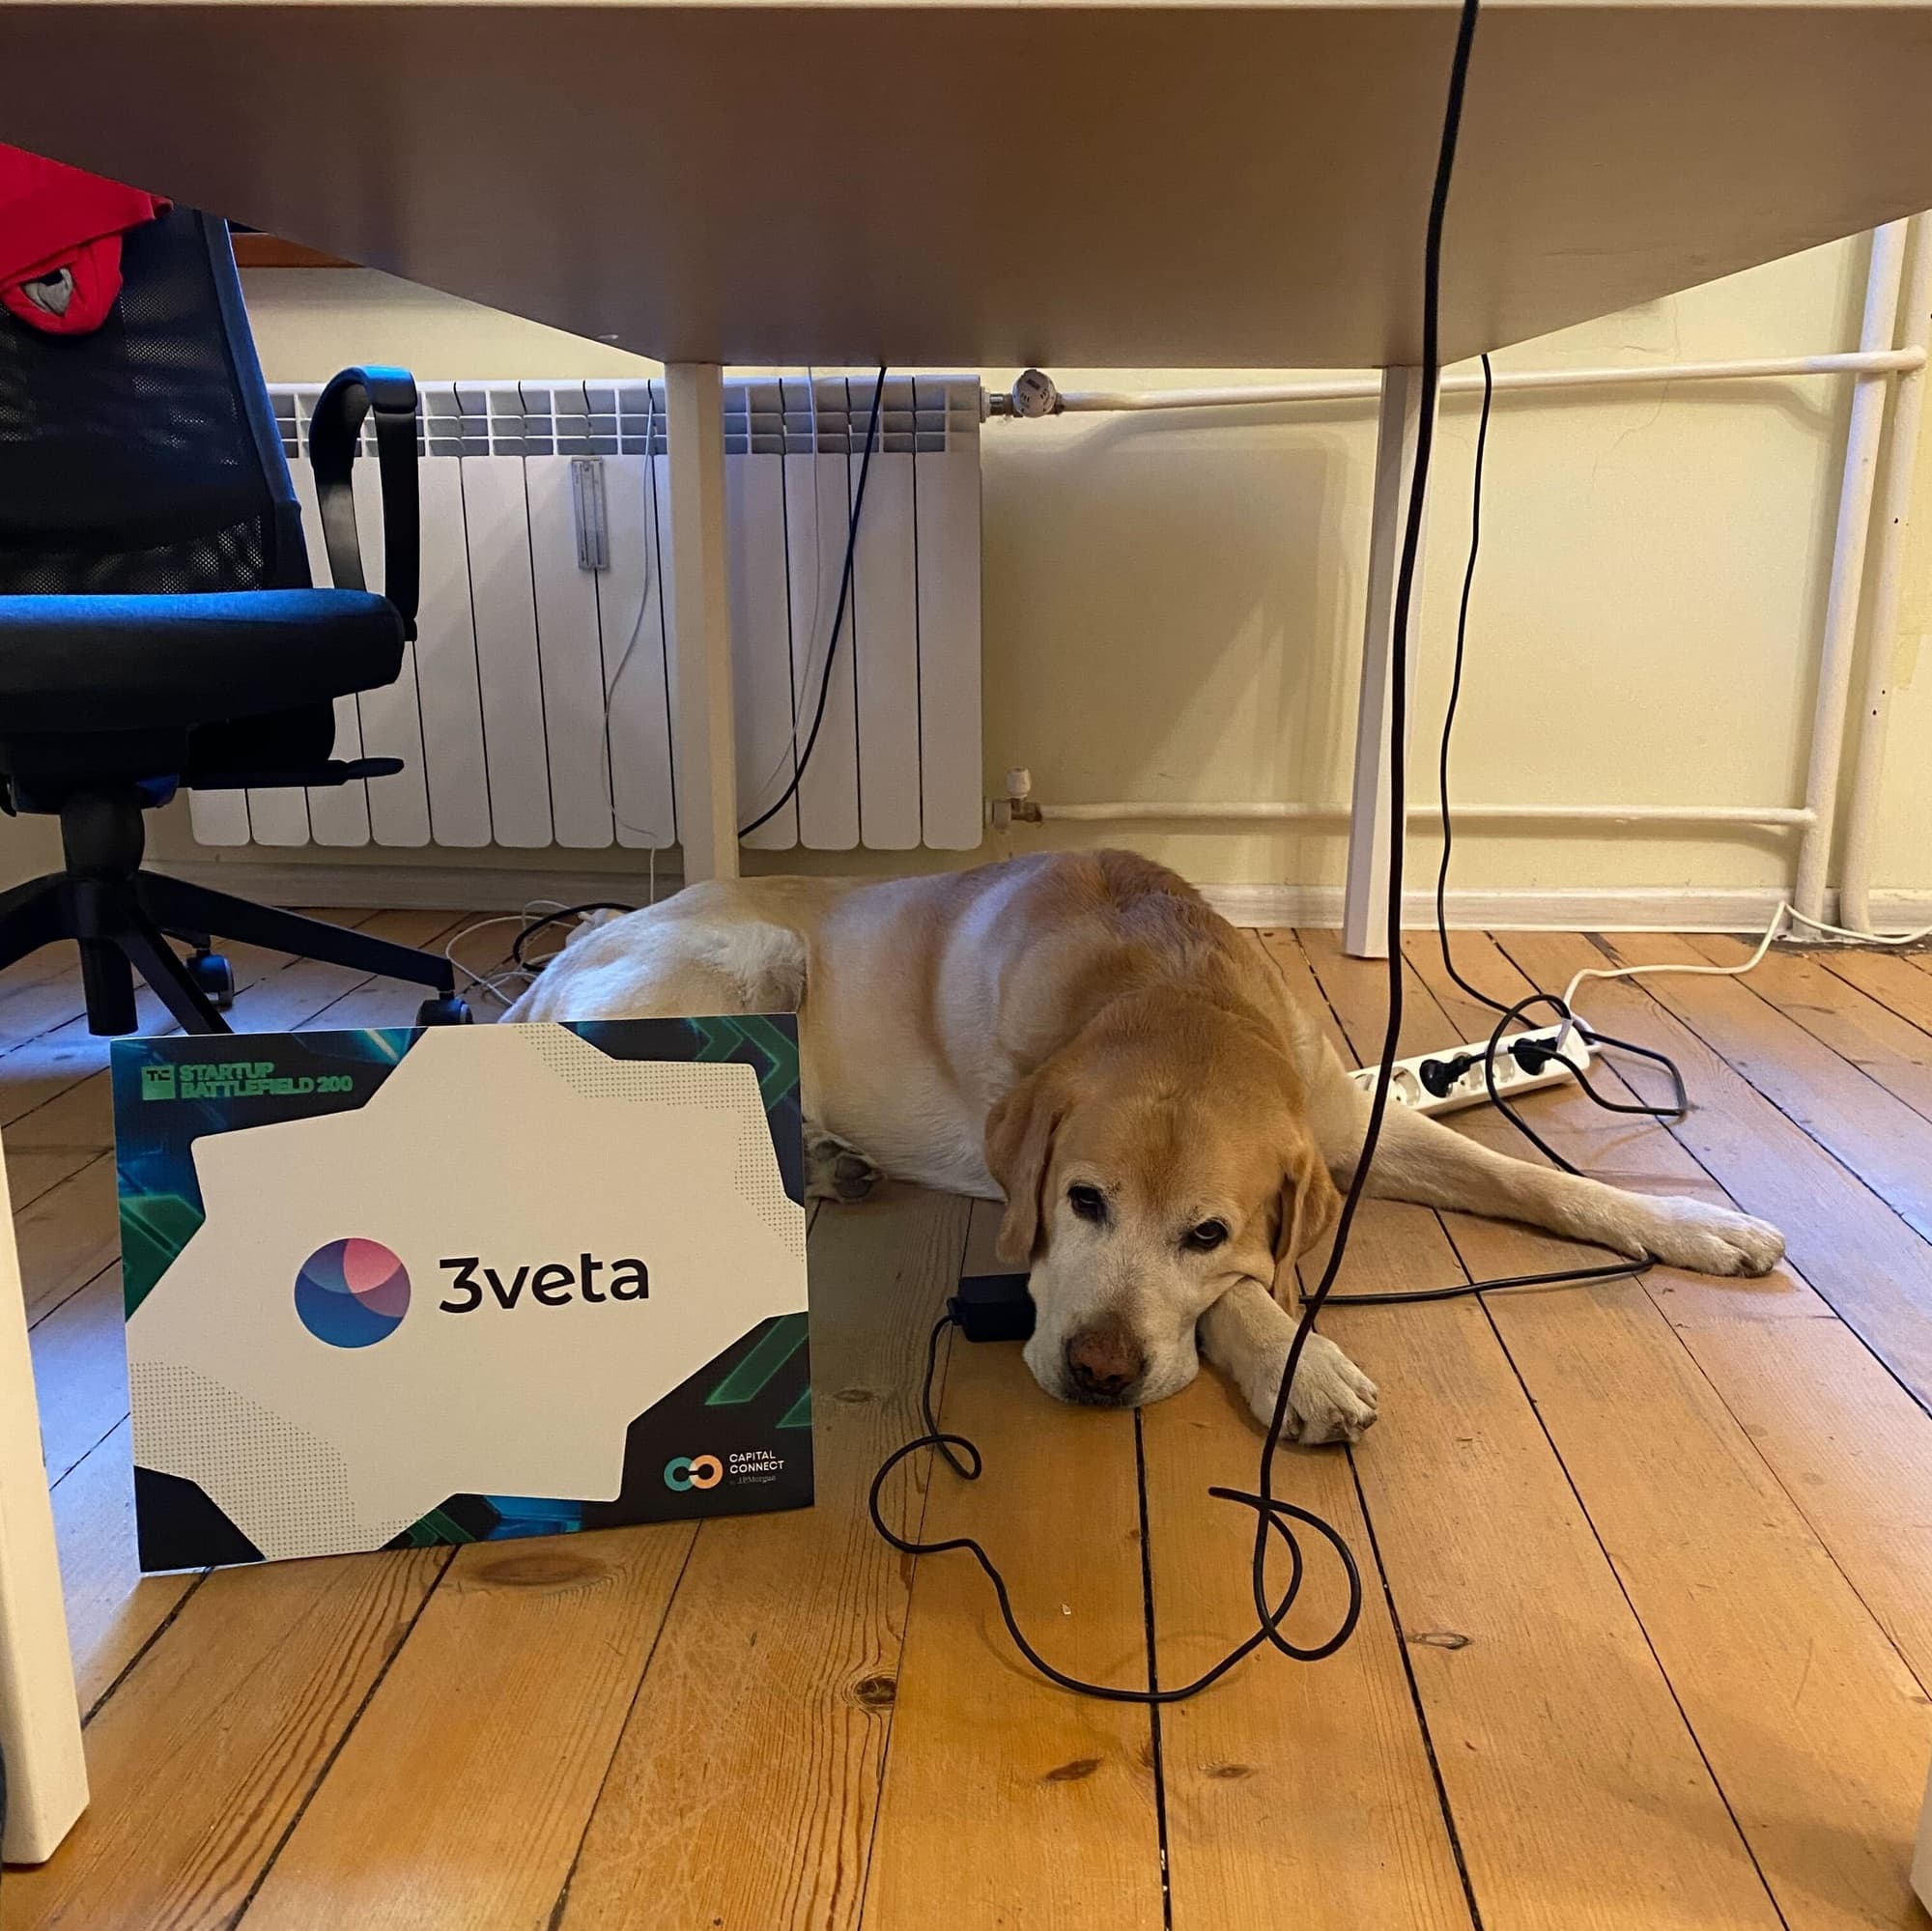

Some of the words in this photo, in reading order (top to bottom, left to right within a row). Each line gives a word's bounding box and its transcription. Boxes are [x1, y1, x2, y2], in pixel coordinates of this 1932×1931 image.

[180, 1063, 273, 1081] STARTUP
[181, 1078, 315, 1097] BATTLEFIELD
[317, 1075, 353, 1093] 200
[439, 1253, 649, 1314] 3veta
[729, 1450, 776, 1462] CAPITAL
[729, 1461, 783, 1474] CONNECT
